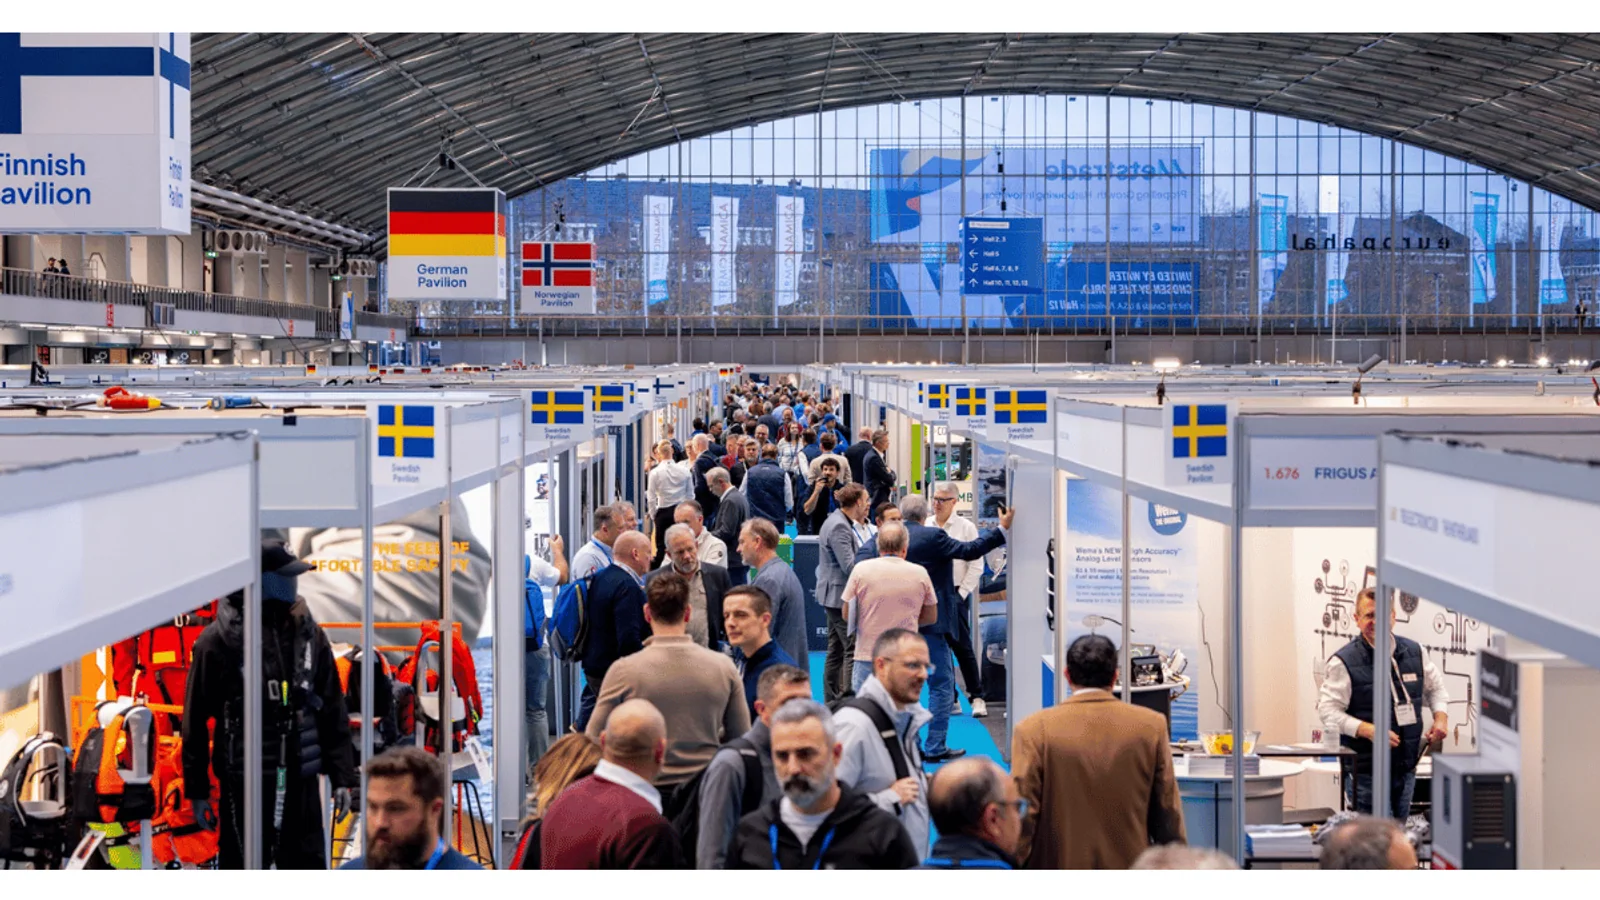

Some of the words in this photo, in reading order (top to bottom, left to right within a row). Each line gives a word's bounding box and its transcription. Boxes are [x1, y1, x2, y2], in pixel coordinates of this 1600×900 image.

[0, 182, 91, 205] avilion
[417, 264, 468, 275] German
[417, 277, 467, 288] Pavilion
[534, 291, 580, 300] Norwegian
[540, 299, 573, 307] Pavilion
[1264, 467, 1300, 480] 1.676
[1314, 467, 1366, 480] FRIGUS
[1076, 555, 1100, 563] Analog
